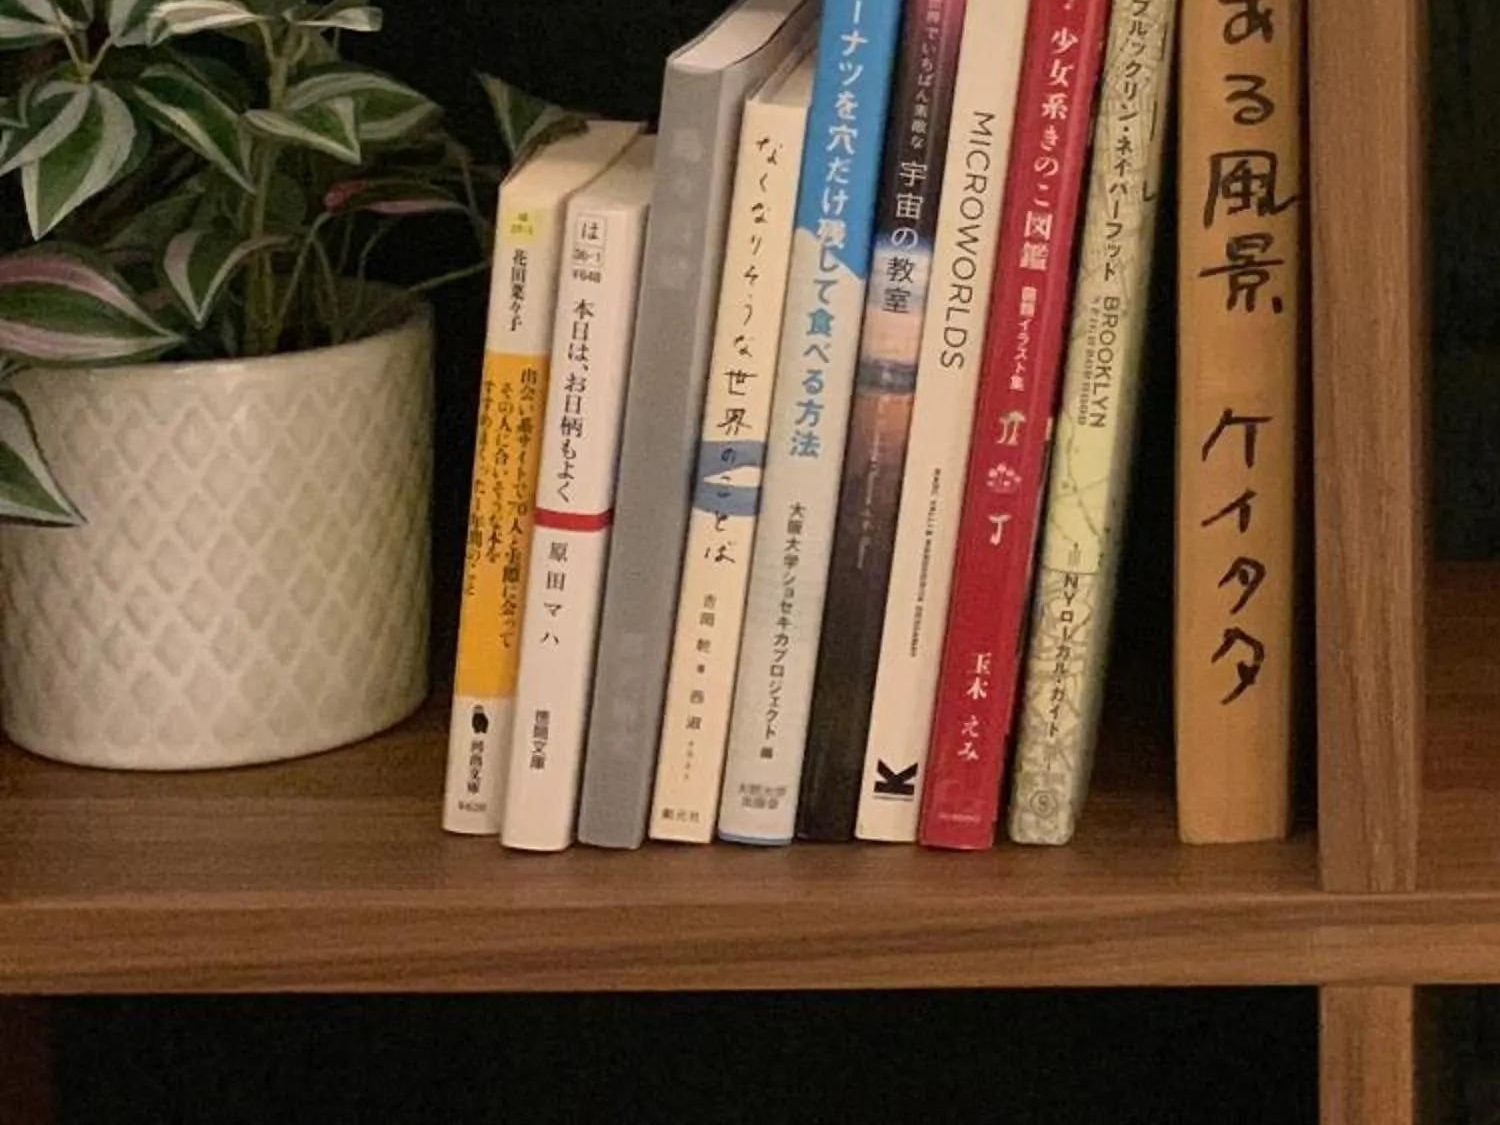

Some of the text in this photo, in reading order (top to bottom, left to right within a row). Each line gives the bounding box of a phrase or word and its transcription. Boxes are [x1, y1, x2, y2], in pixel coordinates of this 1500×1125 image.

[582, 222, 599, 240] は
[882, 160, 928, 314] 宇宙の教室
[1019, 27, 1080, 272] 少女系きのこ図鑑
[941, 112, 995, 370] MICROWORLDS
[557, 298, 595, 503] 本日は、お日柄もよく
[704, 137, 783, 563] なくなりそうな世界のことば
[1089, 296, 1120, 427] BROOKLYN
[541, 541, 569, 645] 原田マハ
